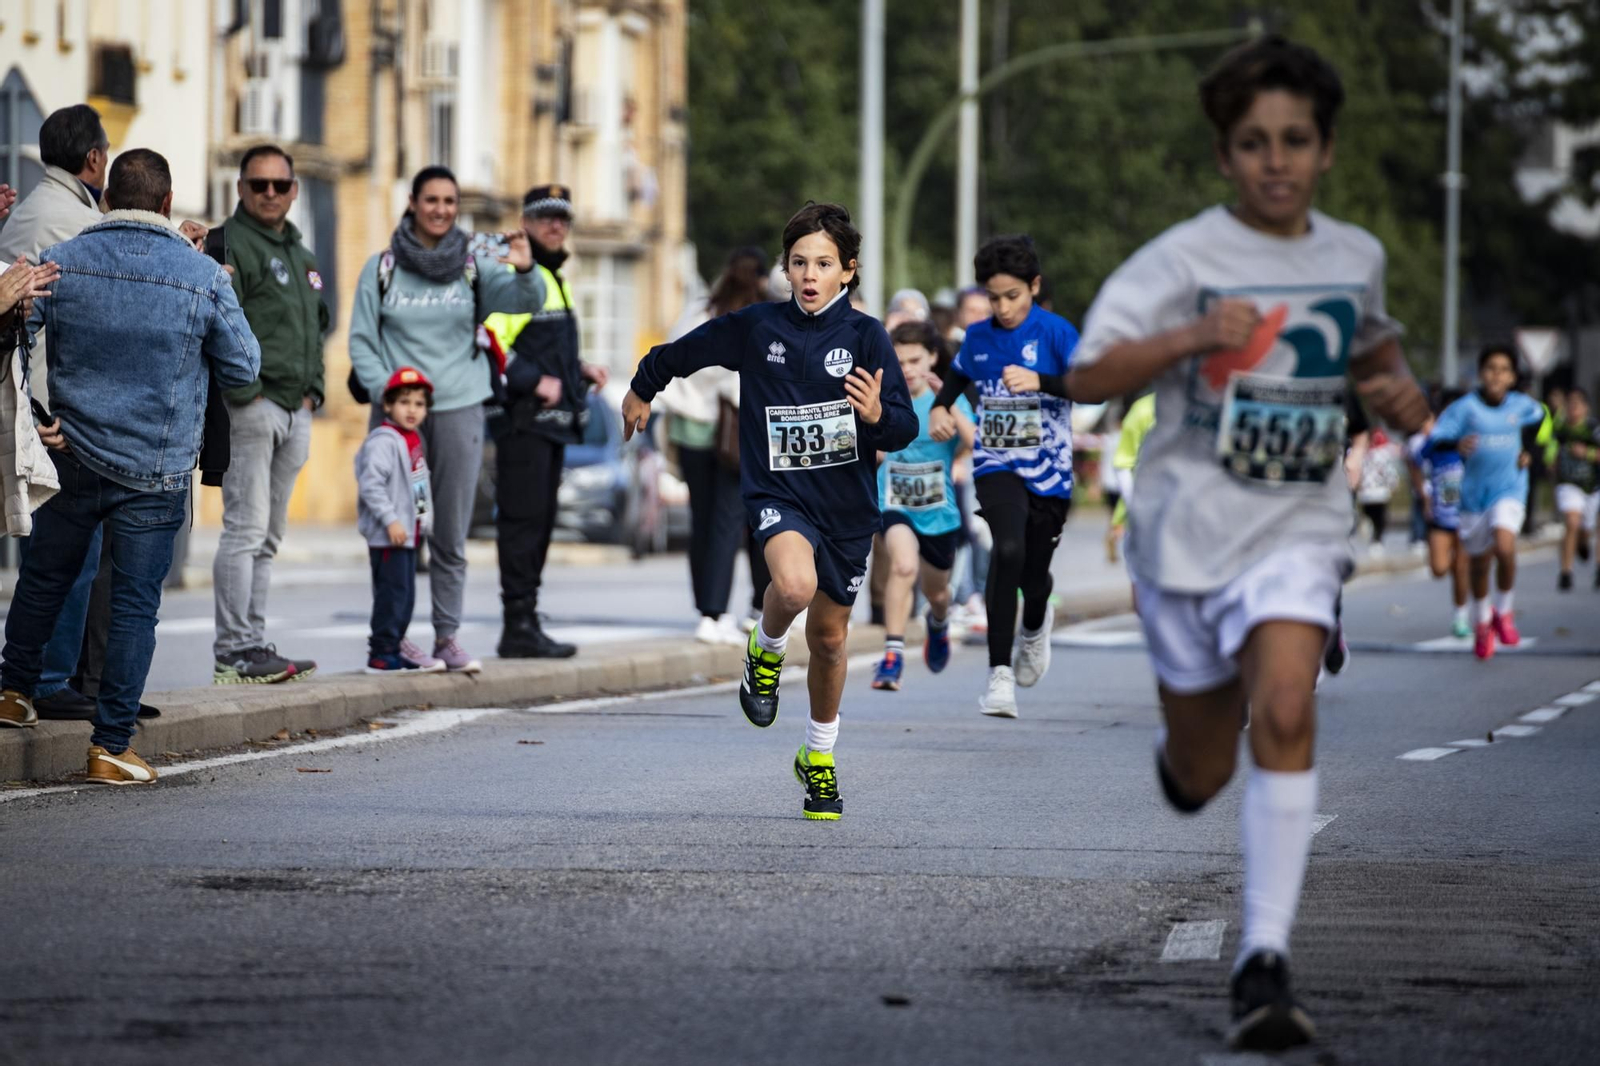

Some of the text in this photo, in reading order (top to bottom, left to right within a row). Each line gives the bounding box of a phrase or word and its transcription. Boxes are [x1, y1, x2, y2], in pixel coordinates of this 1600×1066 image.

[781, 414, 813, 422] BOMBEROS
[797, 407, 821, 415] INFANTIL
[984, 413, 1017, 436] 562
[1234, 410, 1316, 459] 552
[775, 424, 826, 454] 733
[892, 476, 926, 497] 550
